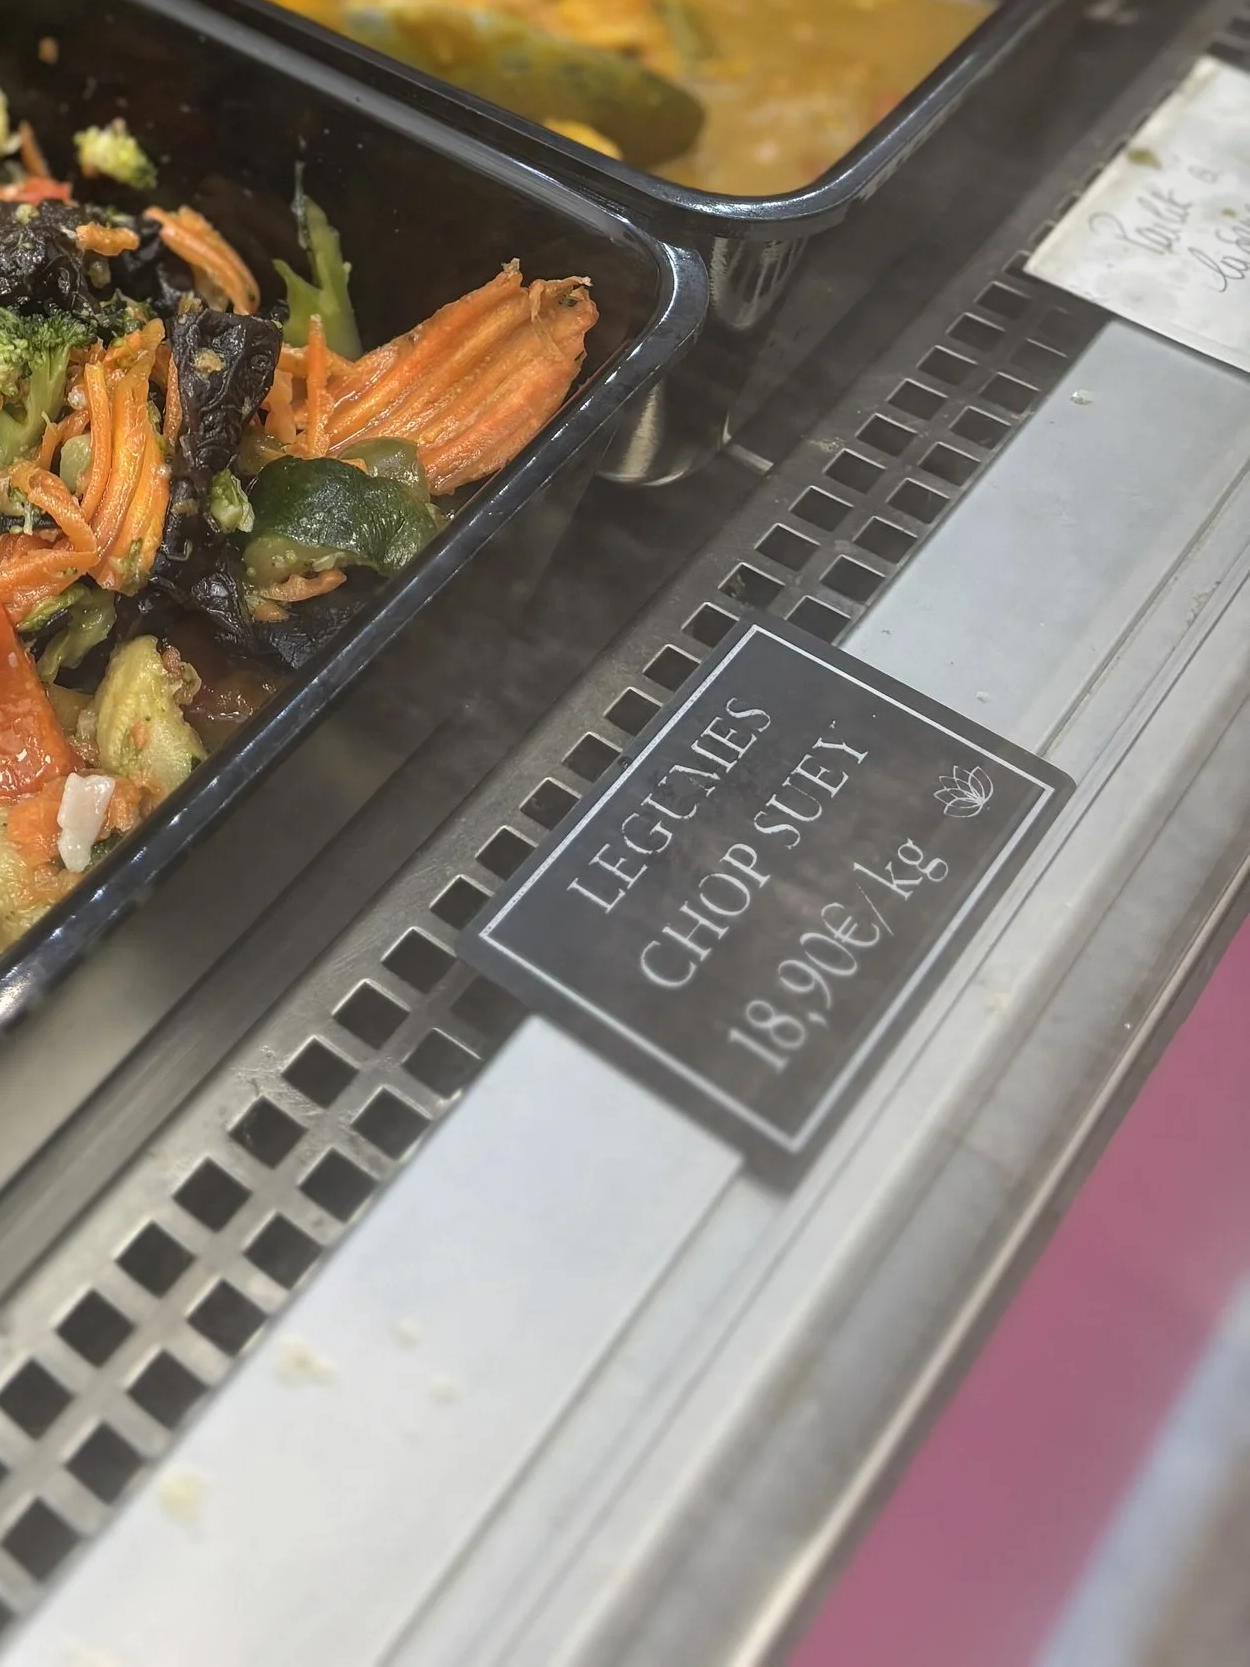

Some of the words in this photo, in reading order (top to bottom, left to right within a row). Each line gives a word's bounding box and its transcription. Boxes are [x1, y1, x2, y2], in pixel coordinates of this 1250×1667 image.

[567, 697, 771, 914] LEGUMES
[639, 843, 771, 989] CHOP
[754, 720, 869, 849] SUEY
